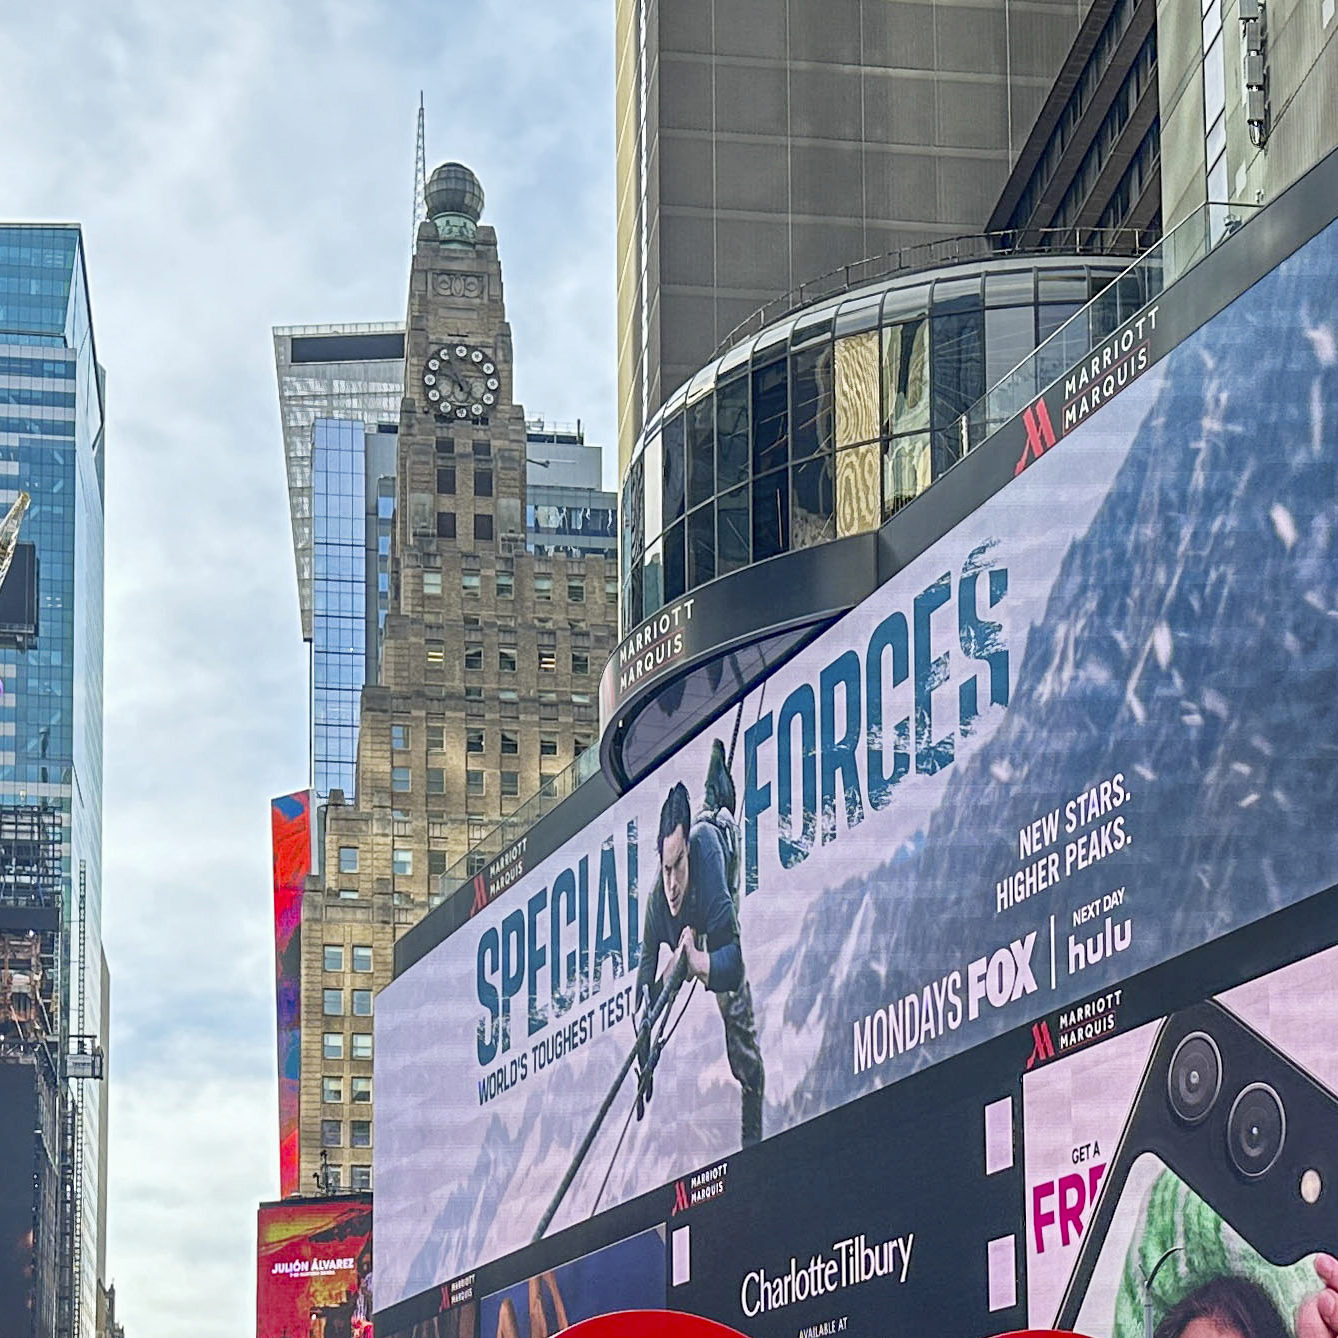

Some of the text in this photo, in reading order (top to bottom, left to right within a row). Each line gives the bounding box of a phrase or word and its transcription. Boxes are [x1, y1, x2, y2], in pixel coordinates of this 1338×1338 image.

[1064, 305, 1159, 400] MARRIOTT
[1064, 347, 1147, 429] MARQUIS
[619, 598, 695, 668] MARRIOTT
[619, 633, 683, 694] MARQUIS
[744, 537, 1010, 897] FORCES
[1019, 773, 1132, 860] NEW STARS.
[489, 837, 528, 879] MARRIOTT
[489, 861, 524, 897] MARQUIS
[996, 816, 1132, 913] HIGHER PEAKS.
[1073, 887, 1126, 927] NEXT DAY
[476, 816, 643, 1067] SPECIAL
[1068, 916, 1132, 975] hulu
[853, 931, 1038, 1075] MONDAYS FOX
[1059, 989, 1122, 1030] MARRIOTT
[1059, 1013, 1115, 1050] MARQUIS
[477, 986, 633, 1106] WORLD'S TOUGHEST TEST
[691, 1162, 728, 1189] MARRIOTT
[1072, 1140, 1101, 1164] GET A
[691, 1181, 724, 1204] MARQUIS
[271, 1259, 309, 1274] JULIÓN
[311, 1257, 354, 1271] ÁLVAREZ
[838, 1316, 848, 1331] AT
